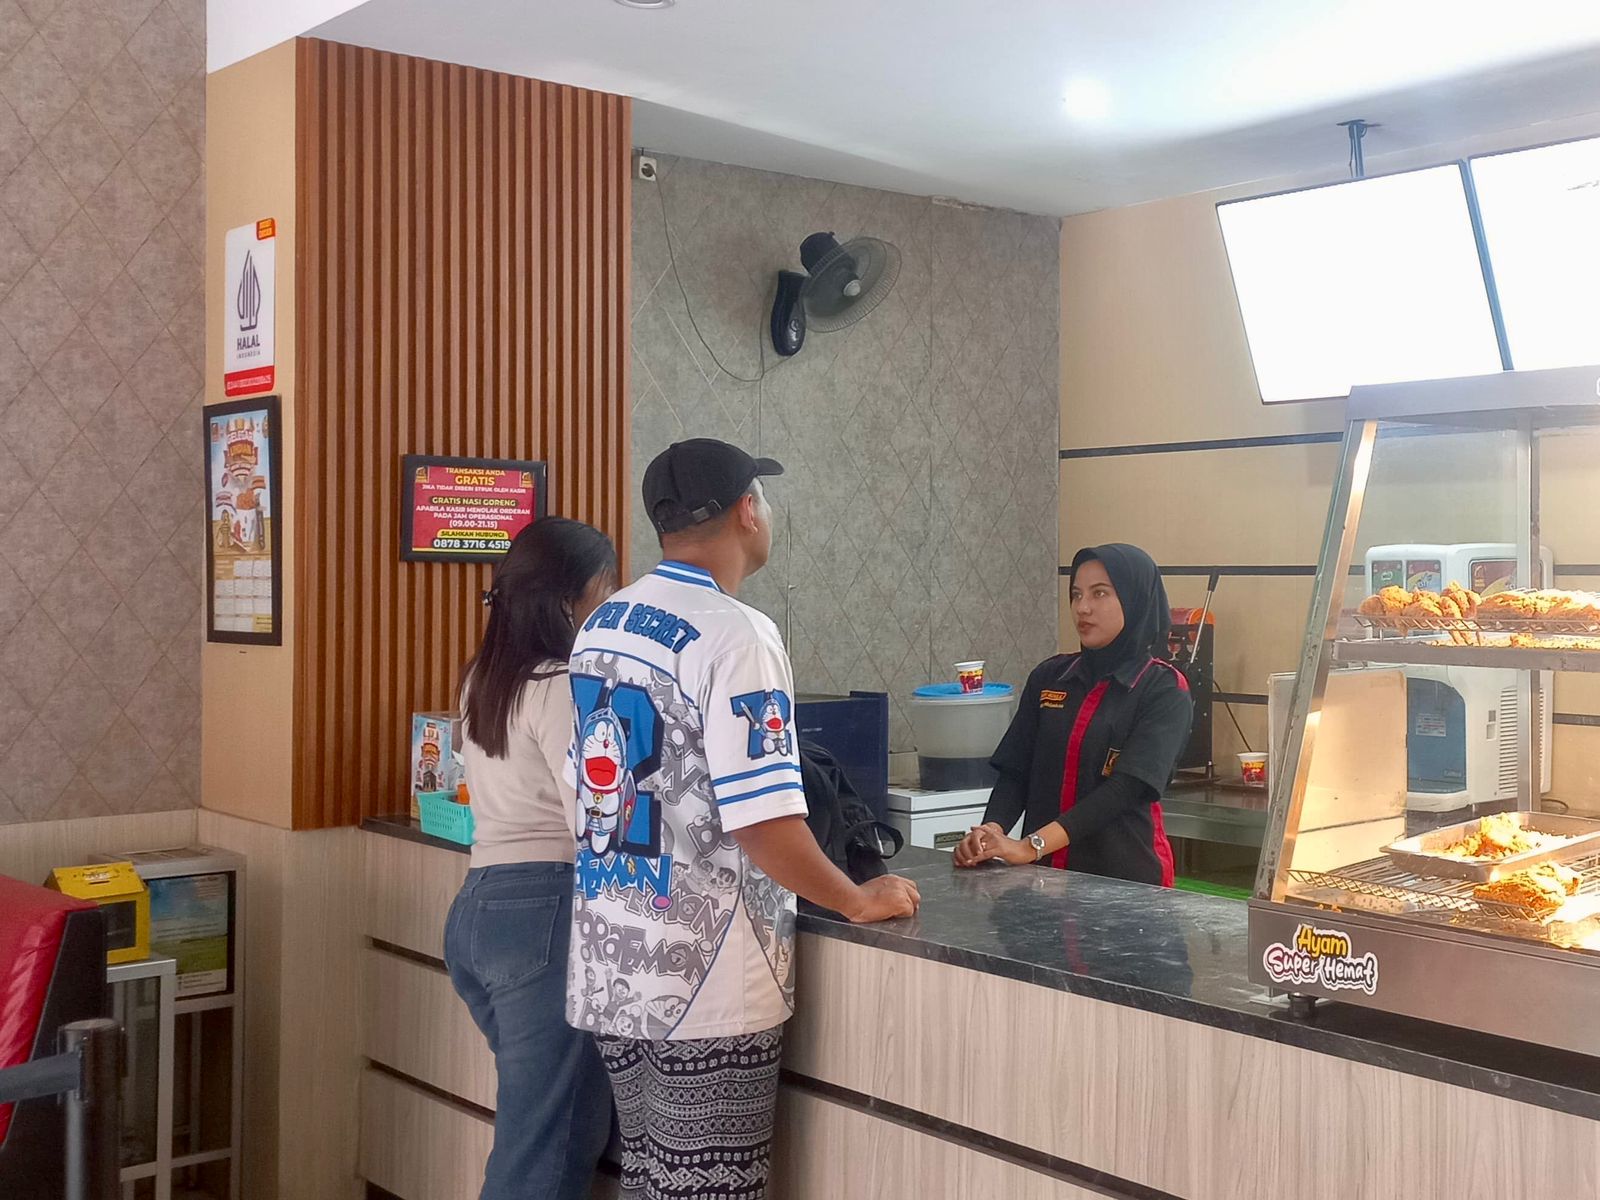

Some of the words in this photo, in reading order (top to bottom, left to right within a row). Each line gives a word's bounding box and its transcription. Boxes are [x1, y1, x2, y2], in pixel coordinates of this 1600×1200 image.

[237, 334, 260, 351] HALAL
[446, 467, 484, 476] TRANSAKSI
[455, 475, 496, 486] GRATIS
[432, 497, 461, 505] GRATIS
[463, 498, 482, 506] NASI
[483, 499, 516, 507] GORENG
[449, 520, 498, 529] (09.00-21.15)
[433, 539, 461, 548] 0878
[462, 540, 486, 549] 3716
[487, 540, 512, 550] 4519
[624, 603, 701, 654] SECRET
[1297, 925, 1349, 958] Ayam
[1266, 946, 1319, 978] Super
[1322, 956, 1375, 988] Hemat
